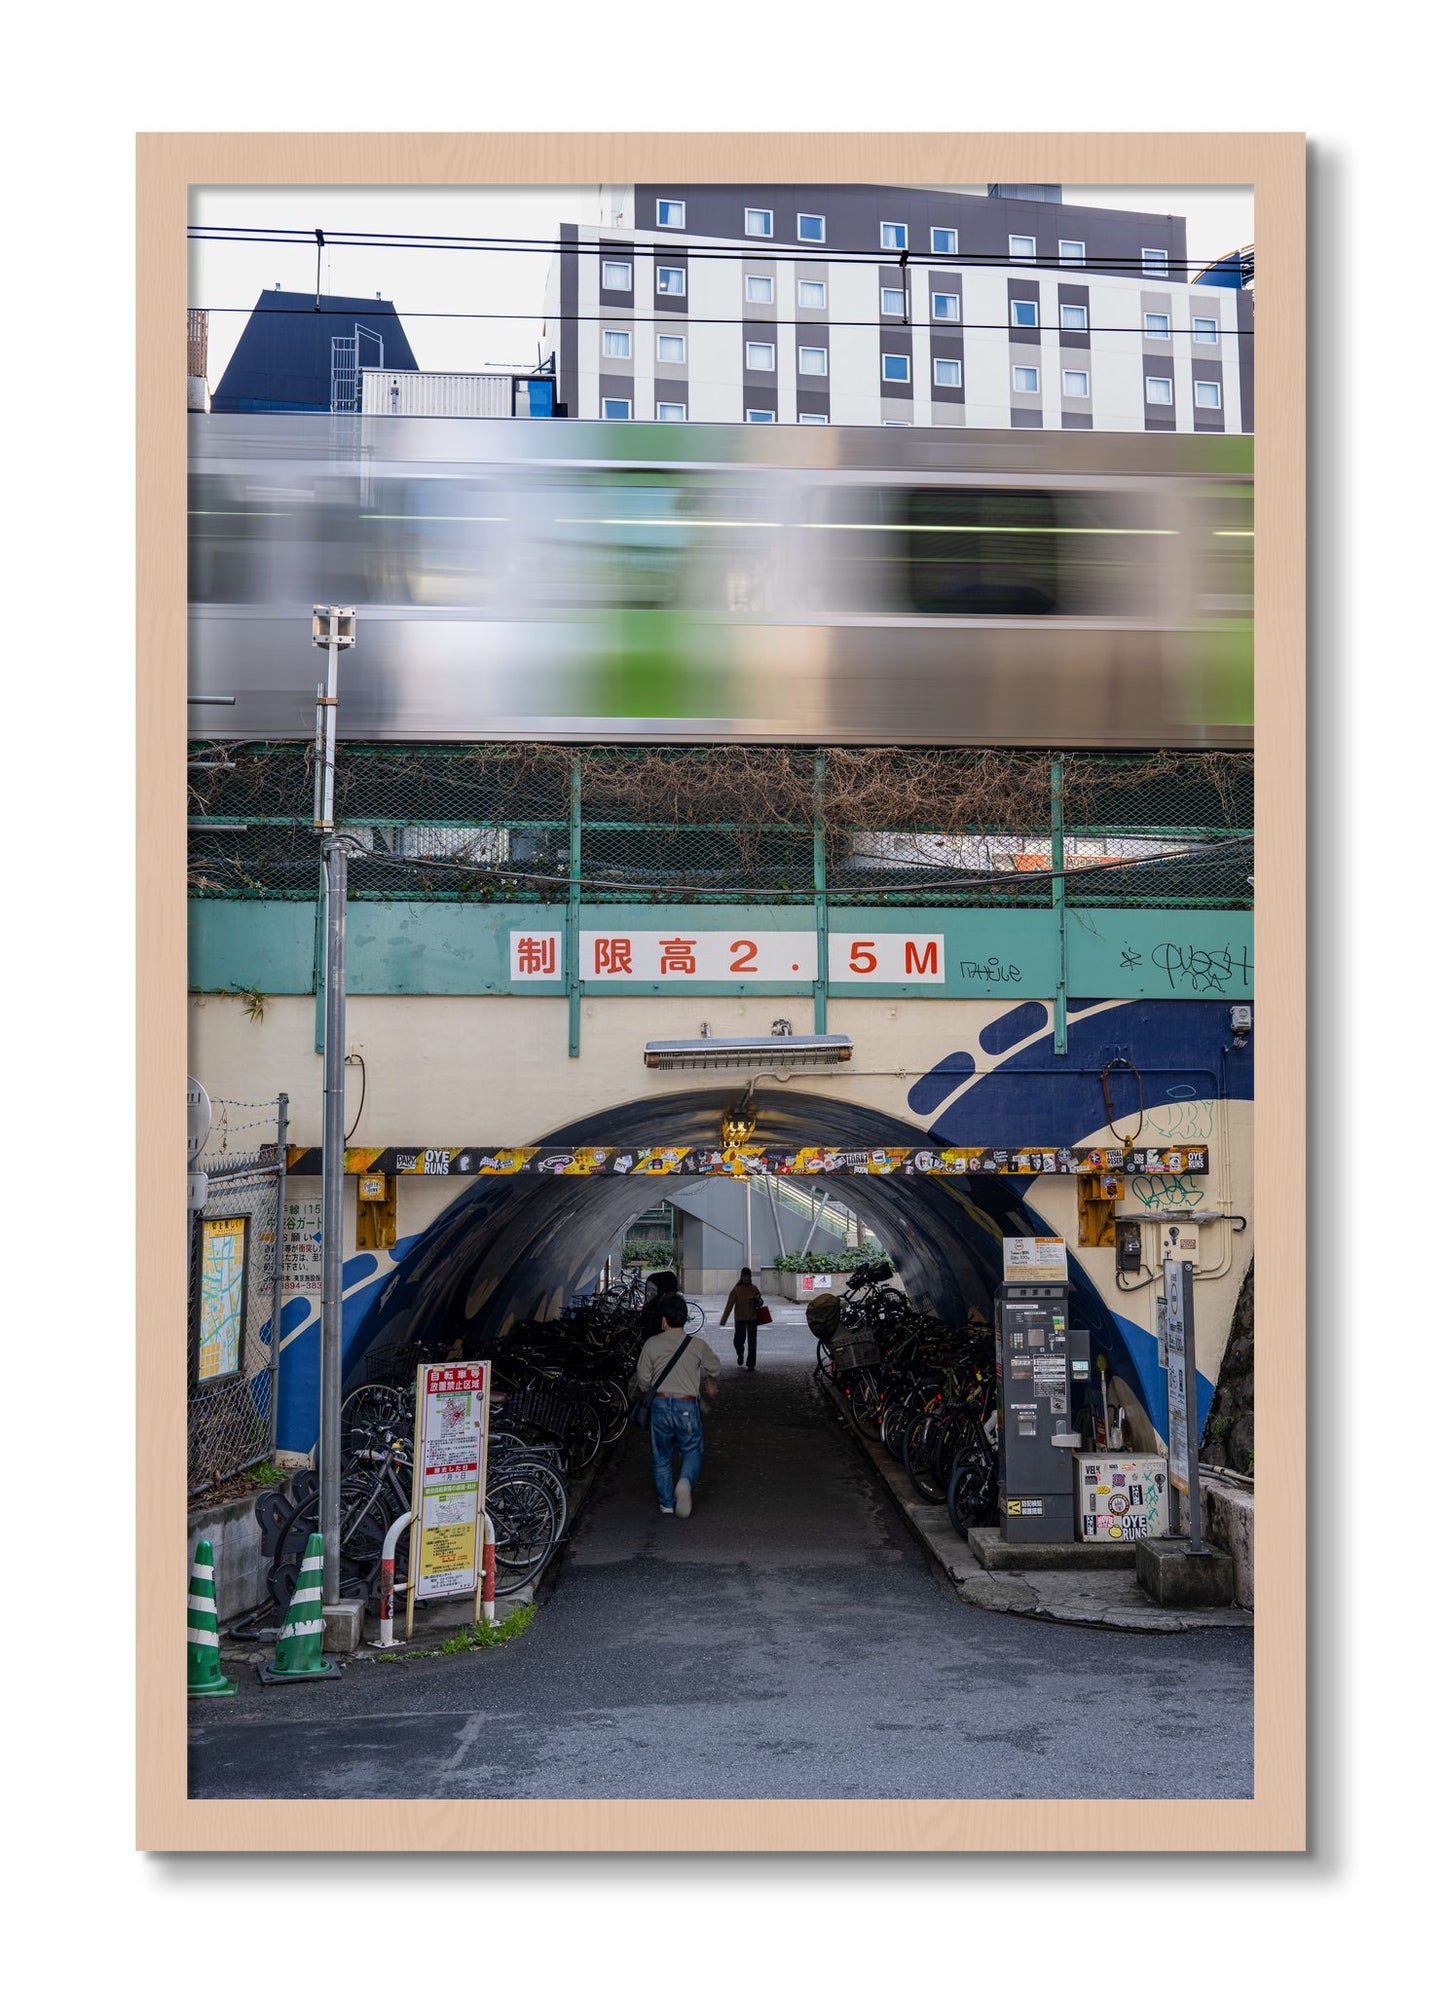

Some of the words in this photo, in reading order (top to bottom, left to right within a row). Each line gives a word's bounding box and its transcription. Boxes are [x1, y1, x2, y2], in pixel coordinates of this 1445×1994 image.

[425, 1150, 450, 1163] OYE
[1187, 1152, 1204, 1161] OYE
[424, 1162, 449, 1175] RUNS
[1188, 1160, 1204, 1169] RUNS
[1122, 1516, 1147, 1528] OYE
[1123, 1527, 1147, 1541] RUNS
